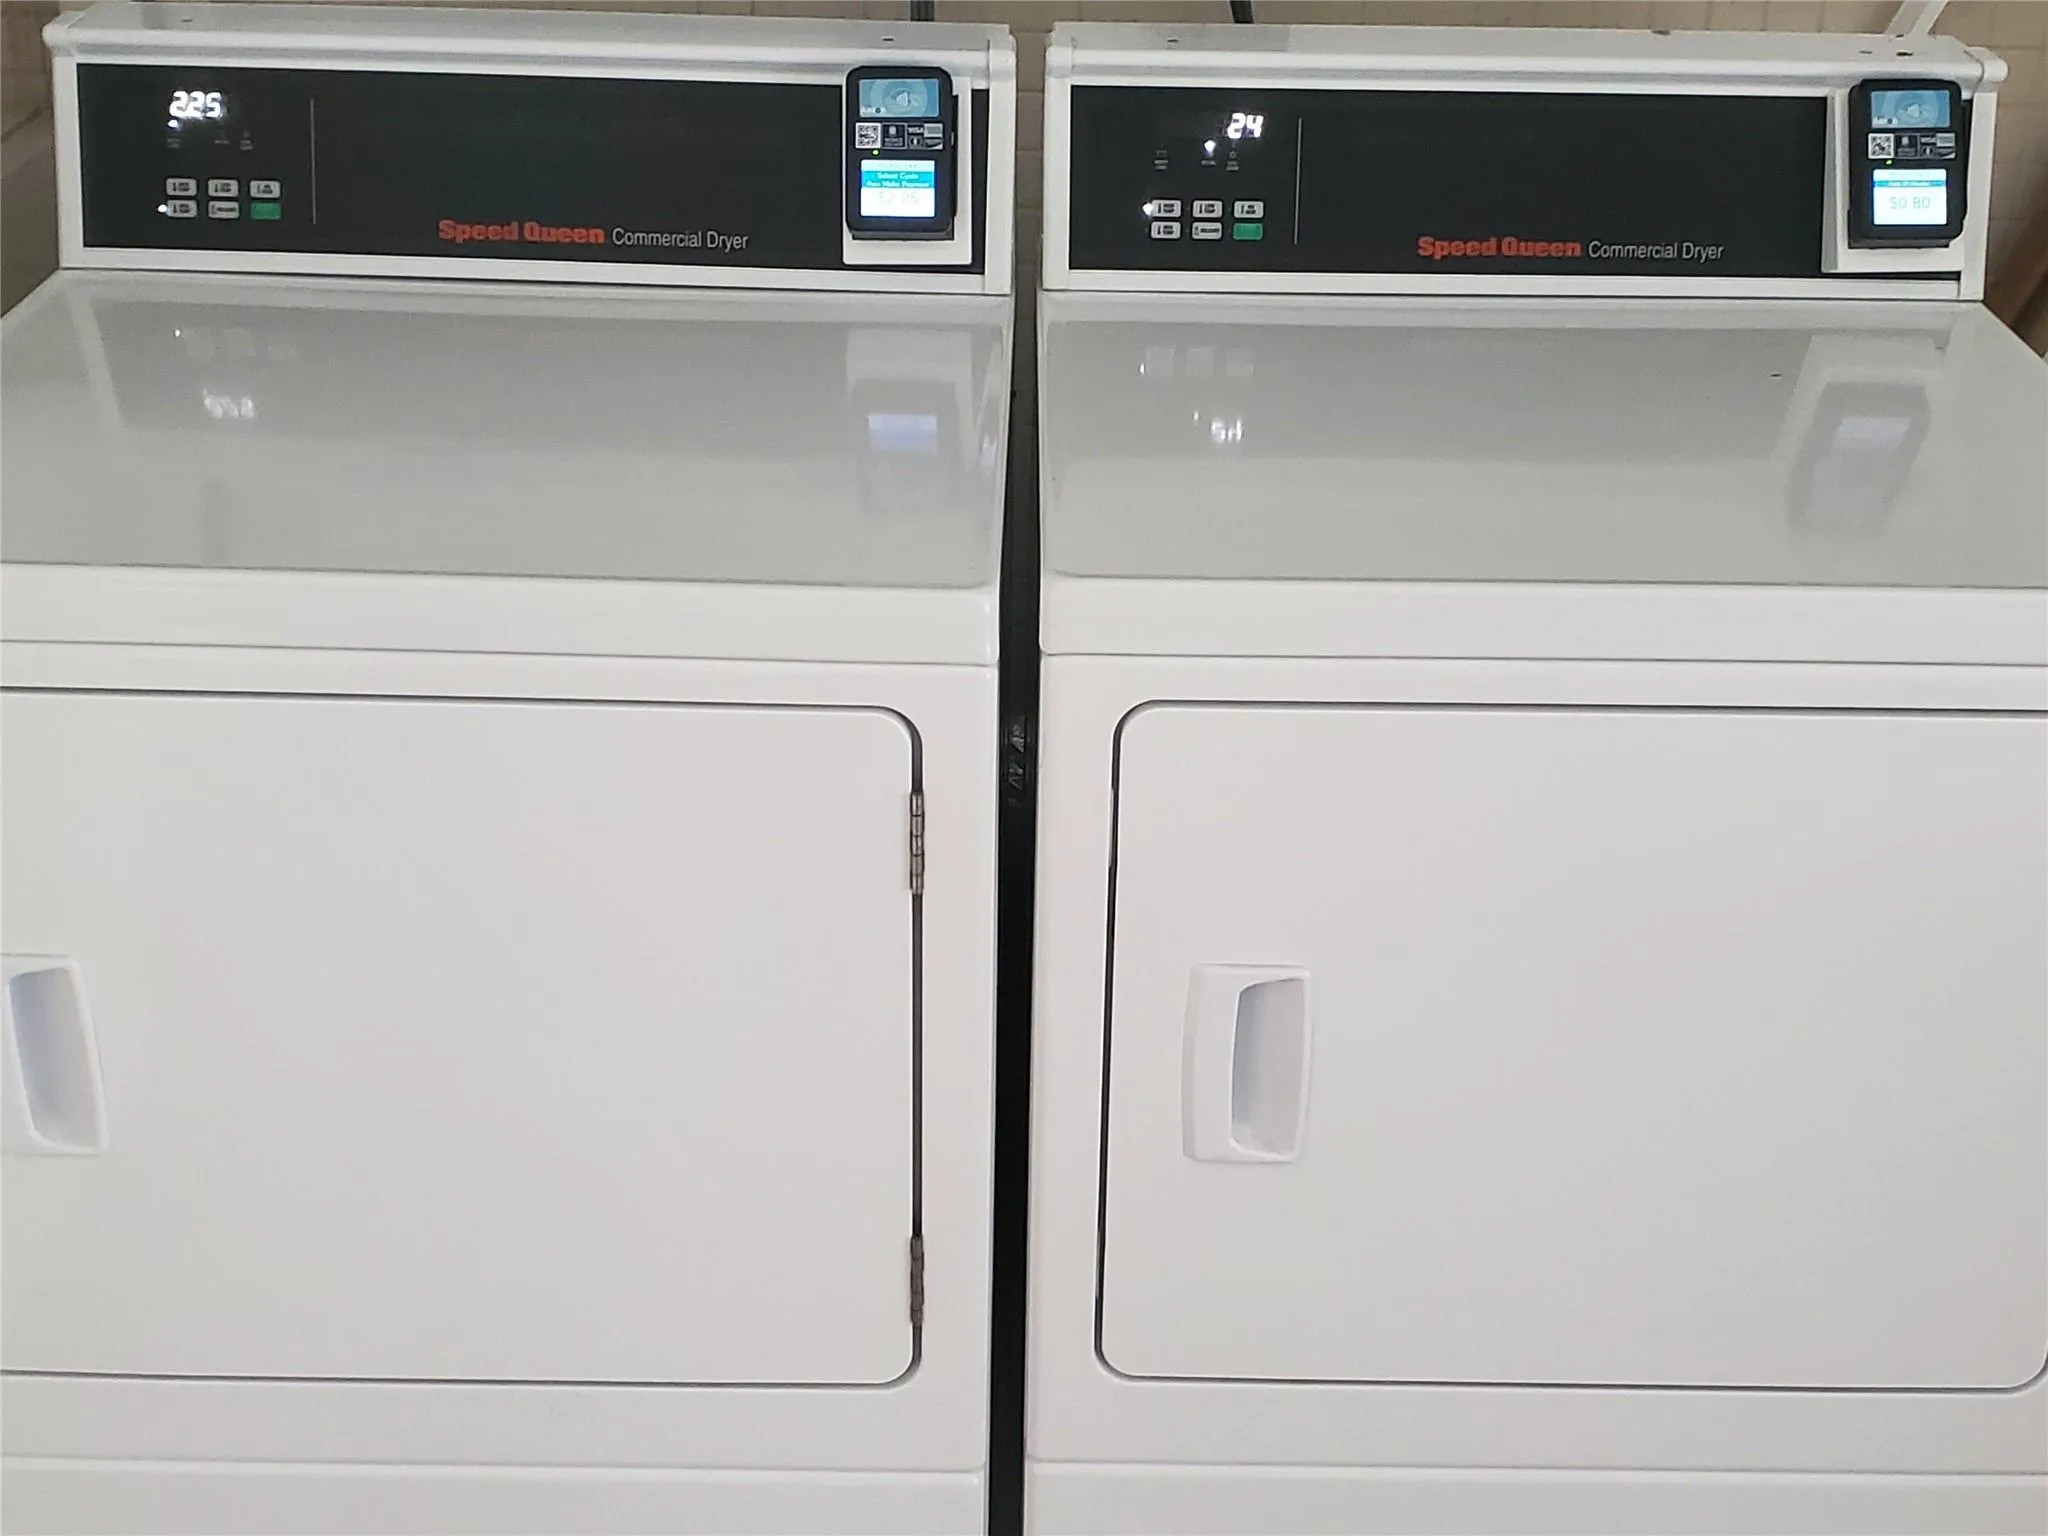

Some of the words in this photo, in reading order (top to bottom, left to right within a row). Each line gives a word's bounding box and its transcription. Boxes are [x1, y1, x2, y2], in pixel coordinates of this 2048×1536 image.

[1227, 112, 1264, 139] 24
[1889, 196, 1931, 210] $080
[438, 218, 519, 244] Speed
[524, 221, 605, 244] Queen
[612, 227, 702, 248] Commercial
[706, 230, 748, 252] Dryer
[1417, 235, 1497, 260] Speed
[1501, 236, 1582, 258] Queen
[1588, 240, 1679, 259] Commercial
[1682, 242, 1725, 263] Dryer
